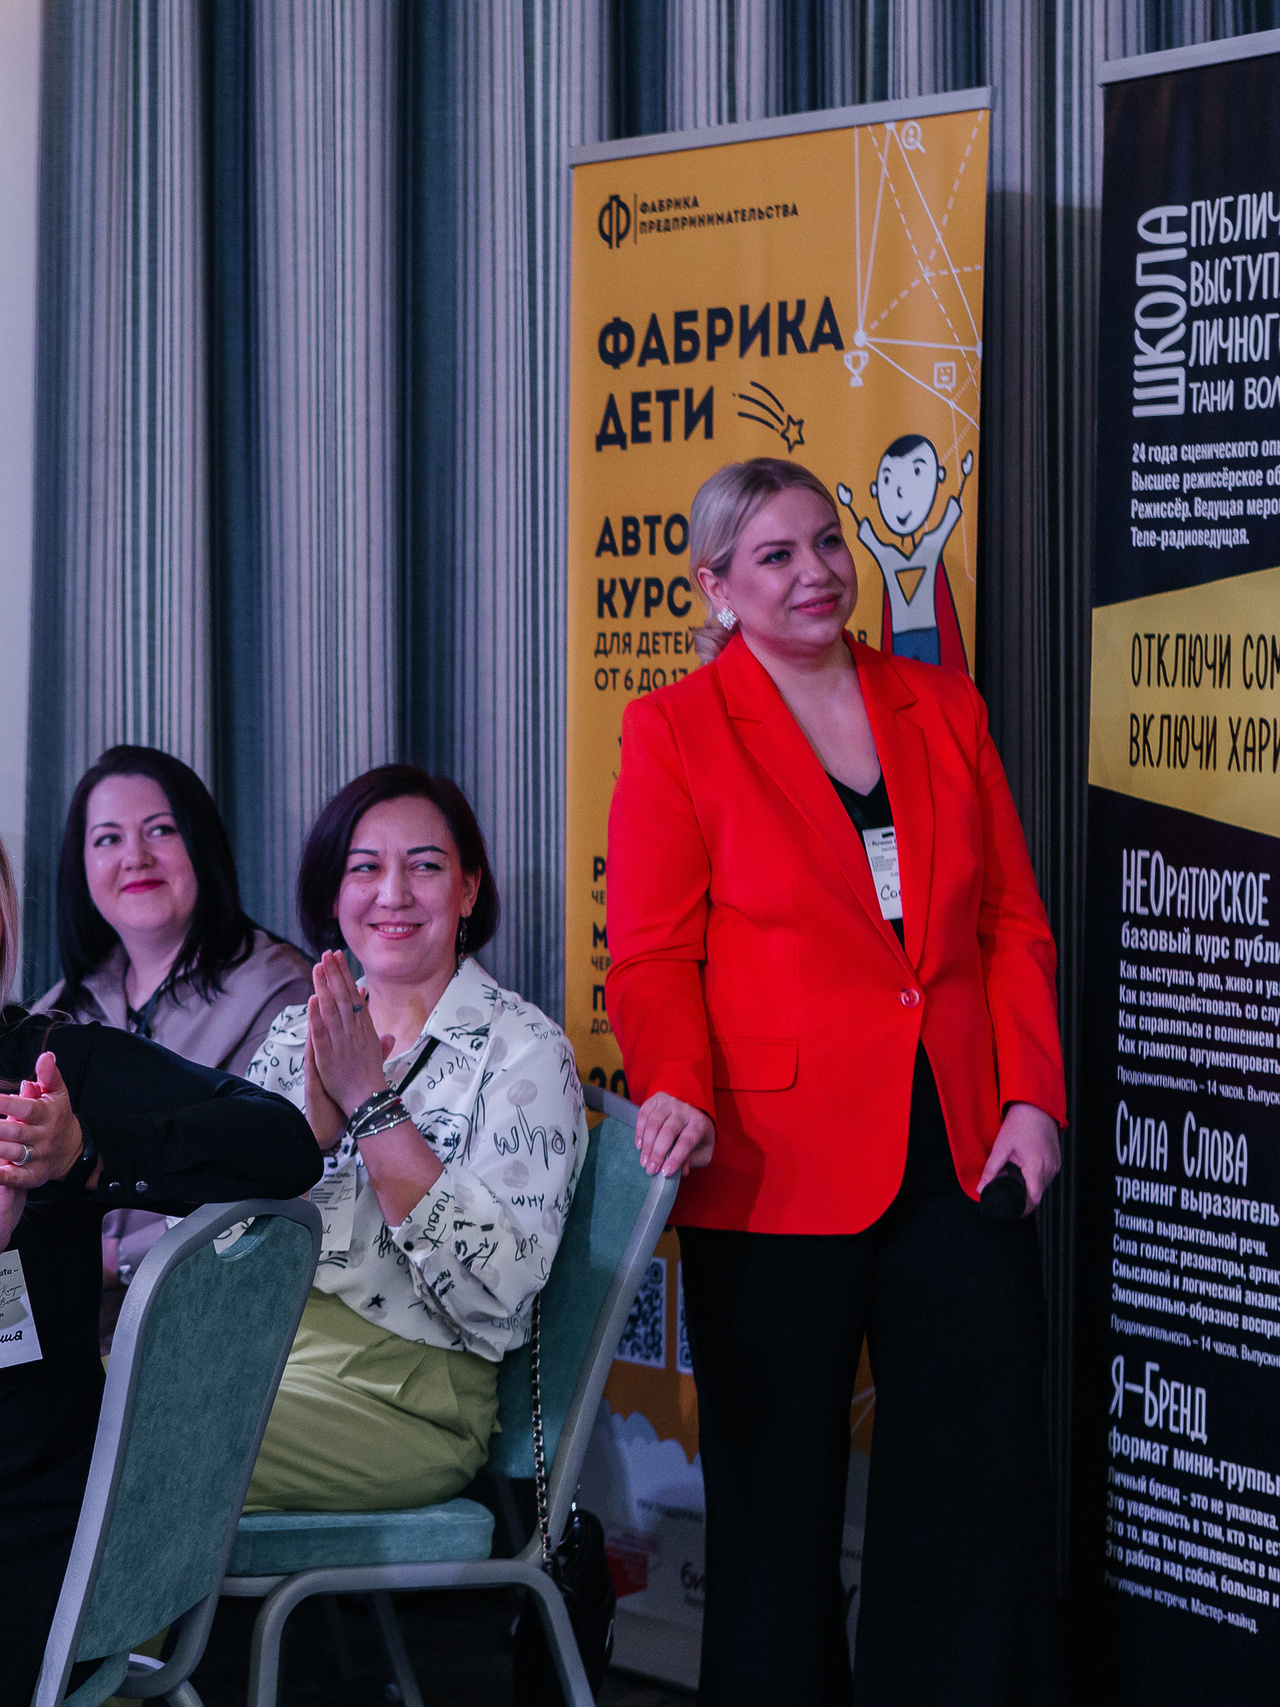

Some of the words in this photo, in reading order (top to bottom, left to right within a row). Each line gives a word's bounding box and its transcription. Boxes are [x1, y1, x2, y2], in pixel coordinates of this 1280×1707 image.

[640, 196, 699, 214] ФАБРИКА
[640, 203, 798, 234] ПРЕДПРИНИМАТЕЛЬСТВА
[1190, 252, 1280, 307] ВЫСТУП
[598, 296, 844, 369] ФАБРИКА
[1133, 205, 1187, 418] ШКОЛА
[1189, 314, 1280, 366] ЛИЧНОГ
[596, 386, 714, 452] ДЕТИ
[1189, 380, 1234, 413] ТАНИ
[1132, 442, 1146, 463] 24
[1149, 445, 1177, 464] года
[1181, 441, 1258, 463] сценического
[1132, 471, 1180, 491] Высшее
[1183, 466, 1263, 493] режиссёрское
[1131, 497, 1191, 522] Режиссёр.
[1194, 497, 1243, 521] Ведущая
[1247, 498, 1280, 519] меро
[1131, 527, 1249, 550] Теле-радиоведущая.
[598, 577, 692, 619] КУРС
[594, 631, 631, 658] ДЛЯ
[637, 626, 695, 658] ДЕТЕЙ
[1131, 632, 1231, 689] ОТКЛЮЧИ
[594, 668, 620, 691] ОТ
[624, 668, 634, 691] 6
[637, 668, 666, 694] ДО
[1129, 713, 1217, 771] ВКЛЮЧИ
[1122, 921, 1191, 955] базовый
[1195, 933, 1229, 964] курс
[1119, 984, 1136, 1005] Как
[1140, 989, 1242, 1018] взаимодействовать
[1246, 1004, 1258, 1020] со
[1120, 960, 1137, 980] Как
[1140, 964, 1194, 987] выступать
[1197, 972, 1223, 992] ярко,
[1226, 976, 1252, 994] живо
[1256, 979, 1263, 995] и
[1266, 980, 1280, 999] ув
[1119, 1009, 1136, 1029] Как
[1139, 1015, 1203, 1039] справляться
[1206, 1024, 1211, 1039] с
[1214, 1025, 1273, 1048] волнением
[1118, 1034, 1135, 1054] Как
[1138, 1039, 1187, 1061] грамотно
[1190, 1047, 1280, 1074] аргументировать
[1118, 1065, 1198, 1093] Продолжительность
[1207, 1080, 1216, 1096] 14
[1219, 1083, 1244, 1100] часов.
[418, 1190, 455, 1251] heart
[511, 1194, 544, 1212] WHY
[1115, 1175, 1177, 1208] тренинг
[1181, 1187, 1280, 1227] выразитель
[1114, 1208, 1153, 1235] Техника
[1157, 1221, 1237, 1251] выразительной
[1240, 1237, 1268, 1257] речи.
[1112, 1258, 1170, 1289] Смысловой
[1173, 1274, 1179, 1290] и
[1182, 1276, 1242, 1304] логический
[1113, 1234, 1137, 1257] Сила
[1140, 1241, 1178, 1264] голоса:
[1181, 1250, 1246, 1282] резонаторы,
[1249, 1263, 1280, 1286] артик
[1112, 1283, 1239, 1328] Эмоционально-образное
[1111, 1313, 1191, 1347] Продолжительность
[1201, 1336, 1210, 1351] 14
[1213, 1341, 1239, 1359] часов.
[1109, 1425, 1169, 1464] формат
[1174, 1448, 1280, 1497] мини-группы
[1107, 1490, 1124, 1512] Это
[1127, 1499, 1190, 1531] уверенность
[1193, 1518, 1199, 1533] в
[1203, 1520, 1224, 1543] том,
[1227, 1528, 1245, 1547] кто
[1248, 1534, 1263, 1553] ты
[1108, 1466, 1146, 1495] Личный
[1149, 1478, 1180, 1505] бренд
[1191, 1492, 1208, 1511] это
[1211, 1496, 1223, 1515] не
[1226, 1501, 1278, 1531] упаковка.
[1106, 1514, 1123, 1537] Это
[1127, 1523, 1139, 1543] то,
[1142, 1528, 1159, 1547] как
[1162, 1533, 1176, 1551] ты
[1179, 1538, 1255, 1576] проявляешься
[1259, 1562, 1265, 1577] в
[1106, 1539, 1123, 1561] Это
[1126, 1548, 1160, 1574] работа
[1164, 1559, 1183, 1582] над
[1185, 1567, 1218, 1592] собой,
[1221, 1574, 1269, 1606] большая
[1273, 1592, 1280, 1608] и
[1155, 1587, 1189, 1611] встречи.
[1192, 1597, 1258, 1634] Мастер-майнд.
